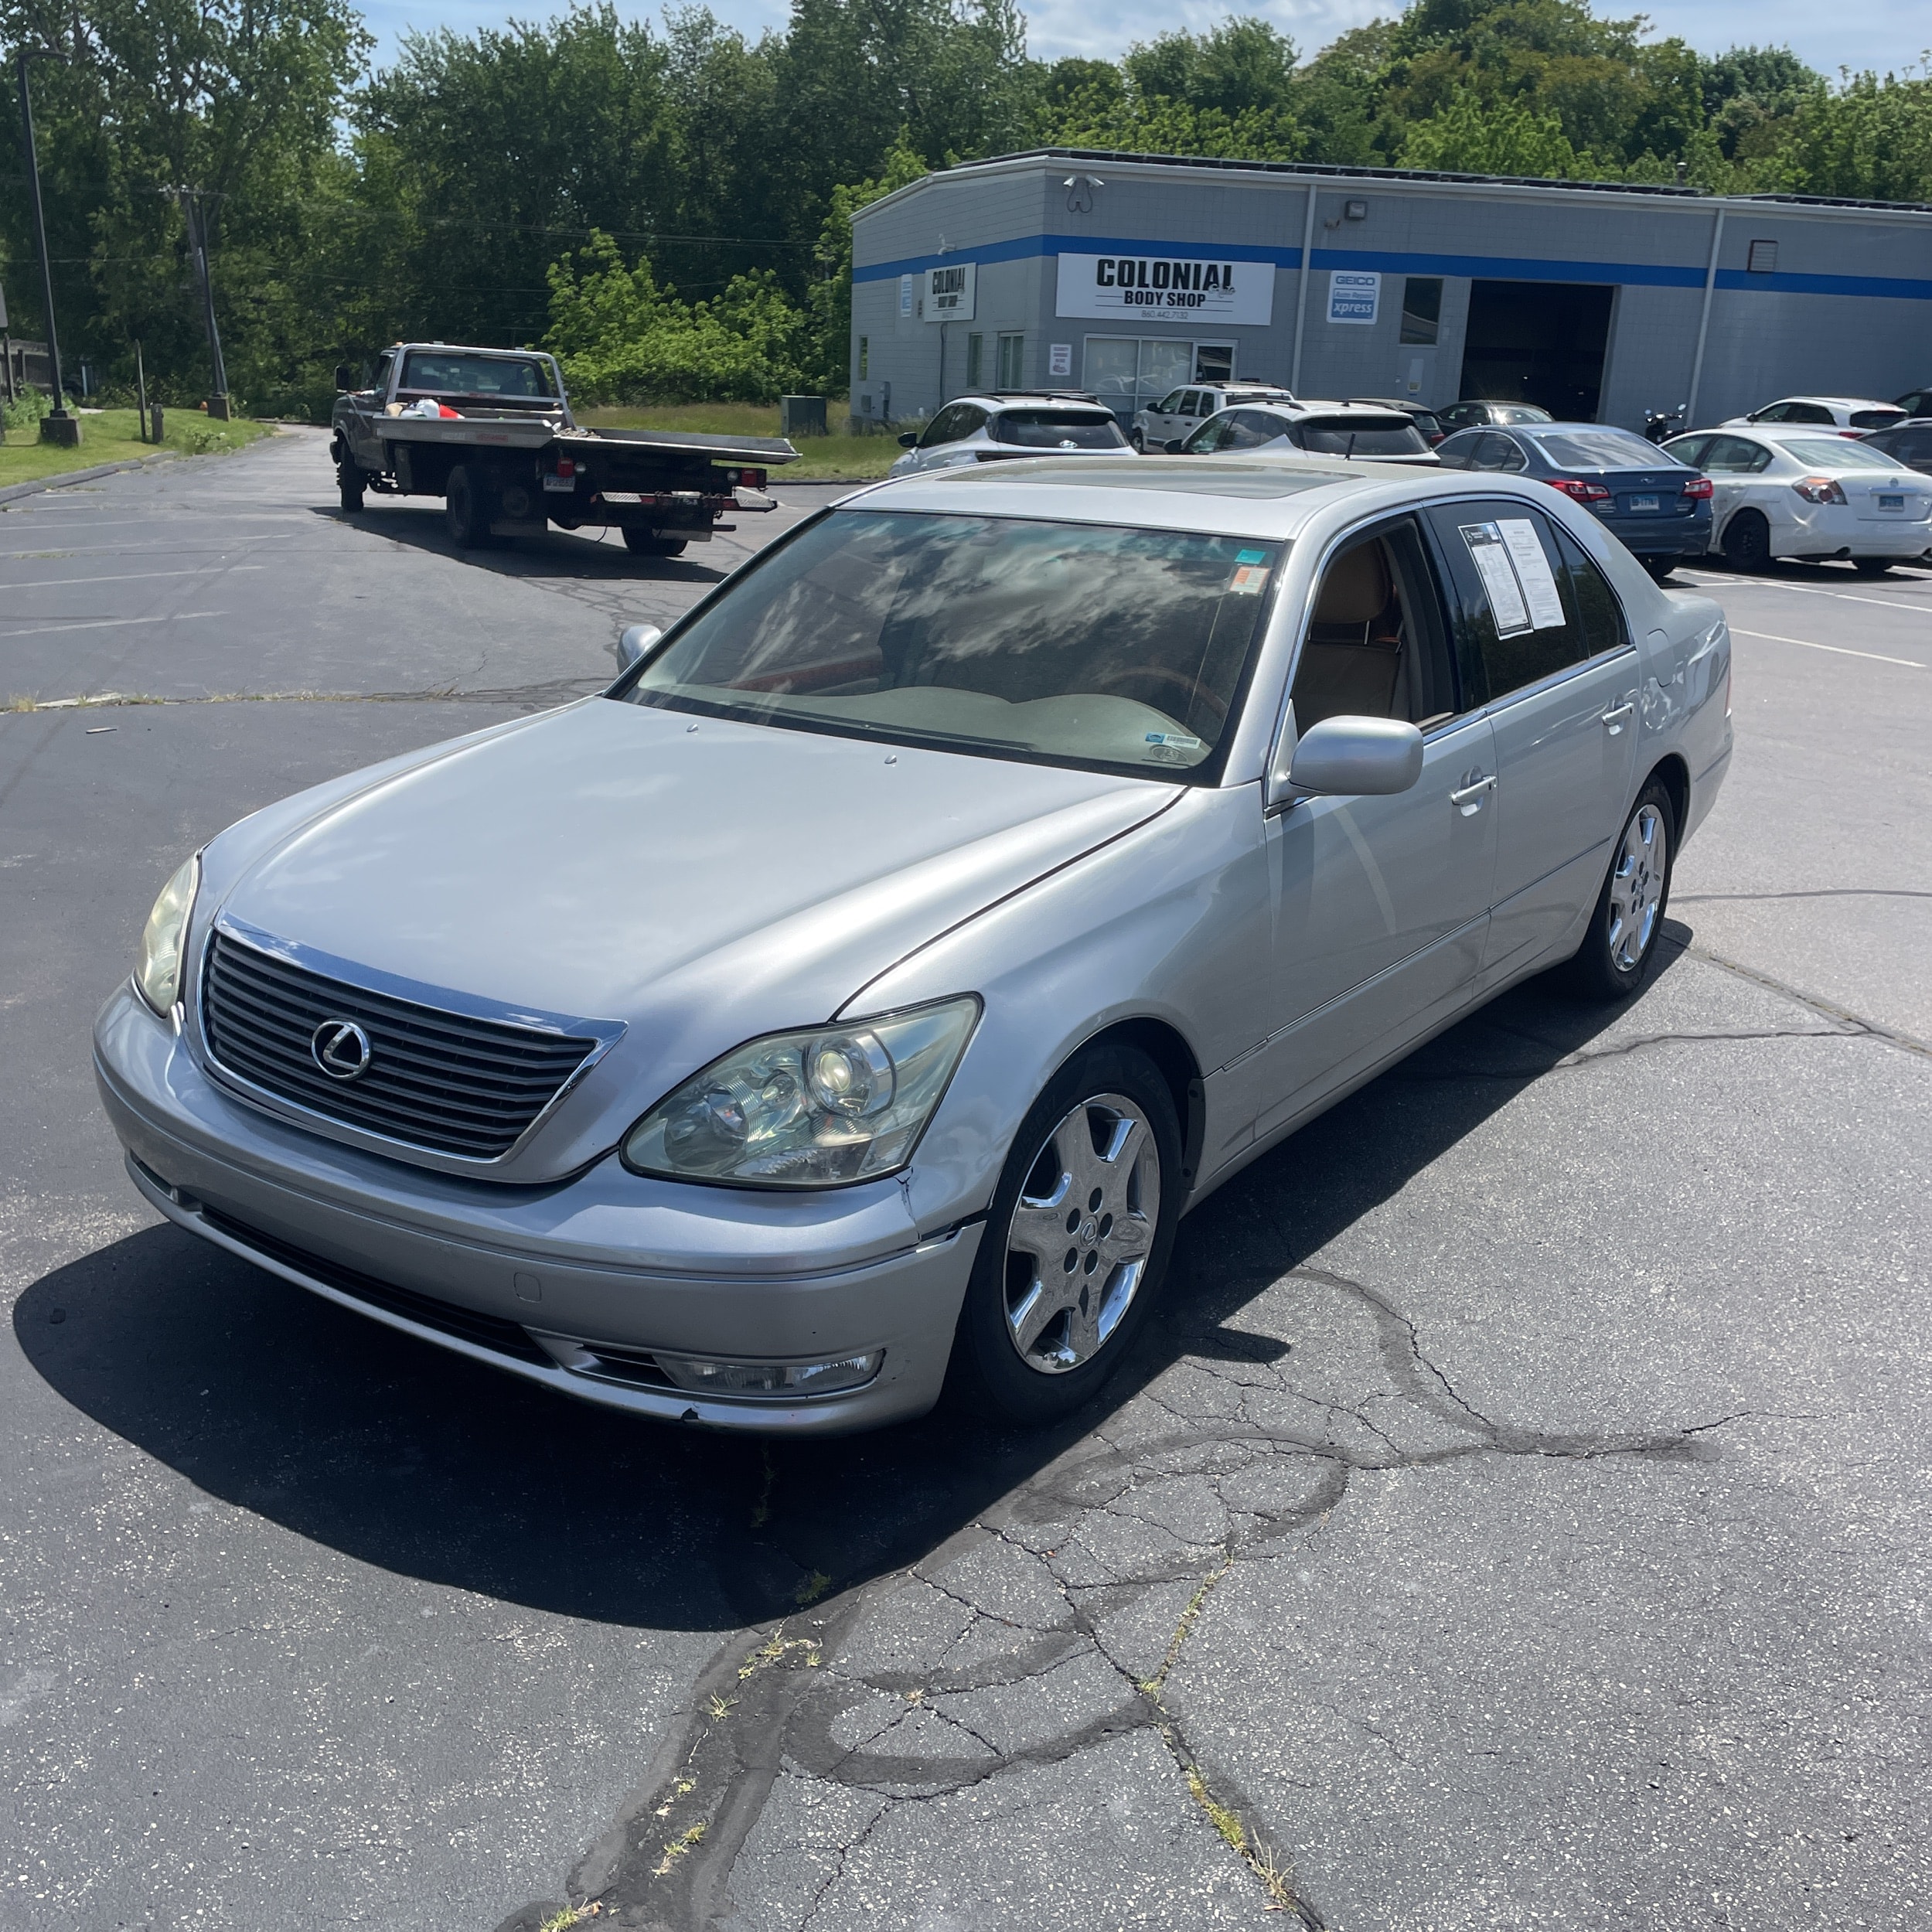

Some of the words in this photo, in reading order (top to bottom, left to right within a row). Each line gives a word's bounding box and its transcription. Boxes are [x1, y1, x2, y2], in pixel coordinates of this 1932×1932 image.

[1097, 259, 1232, 291] COLONIAL
[1336, 276, 1375, 285] GEICO
[1124, 291, 1163, 305] BODY
[1167, 293, 1206, 308] SHOP
[1334, 302, 1372, 315] xpress
